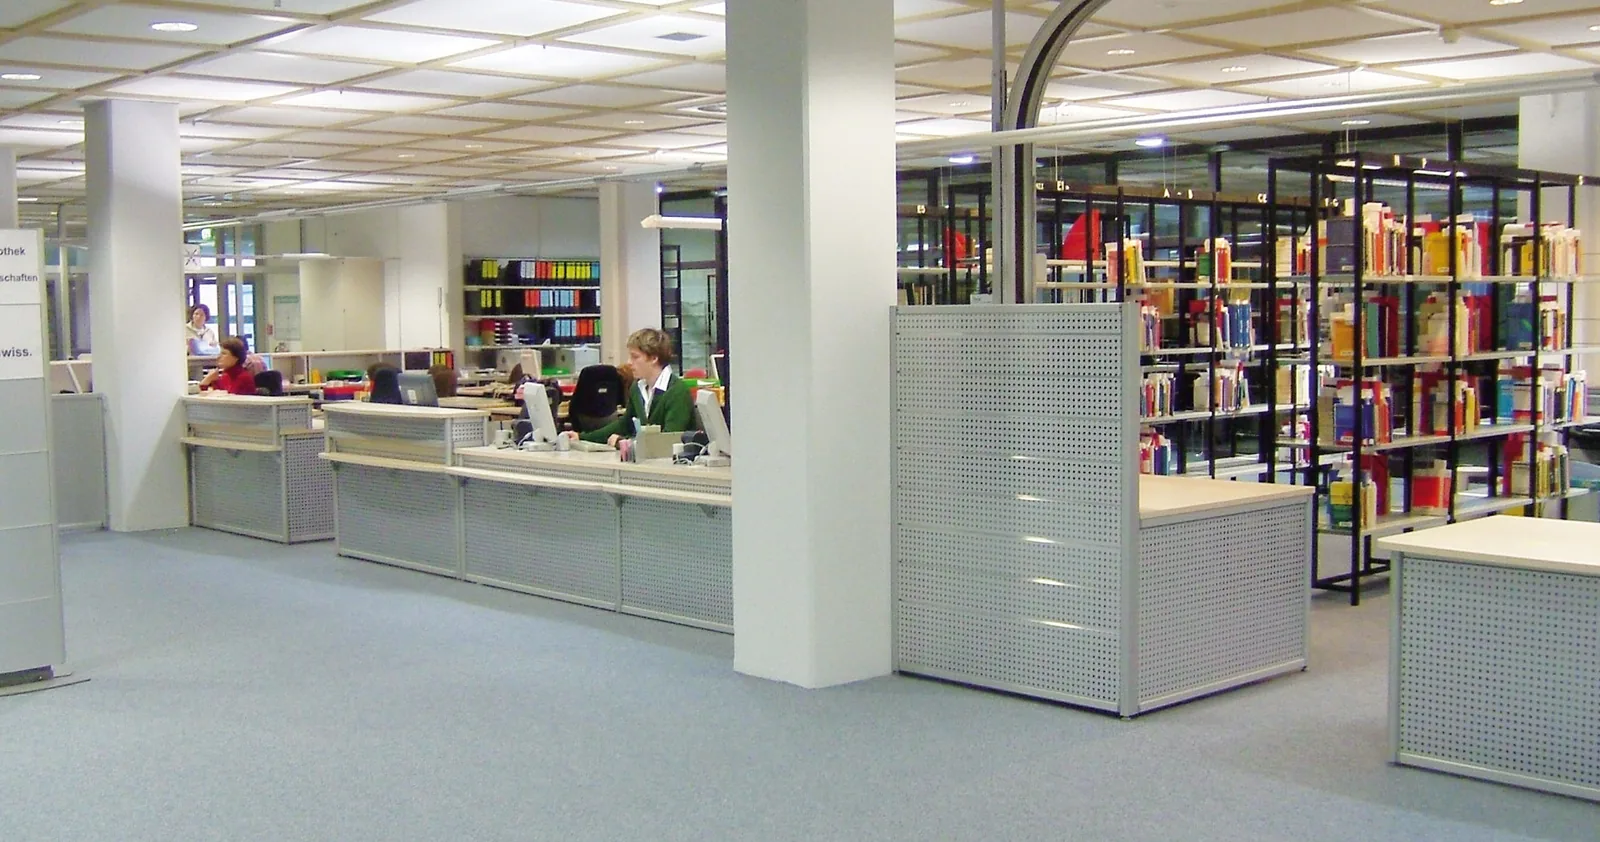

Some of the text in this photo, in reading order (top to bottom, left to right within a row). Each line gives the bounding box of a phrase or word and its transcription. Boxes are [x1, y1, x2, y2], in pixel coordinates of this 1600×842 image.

[1163, 188, 1170, 198] A
[0, 247, 26, 256] othek
[0, 273, 38, 282] schaften
